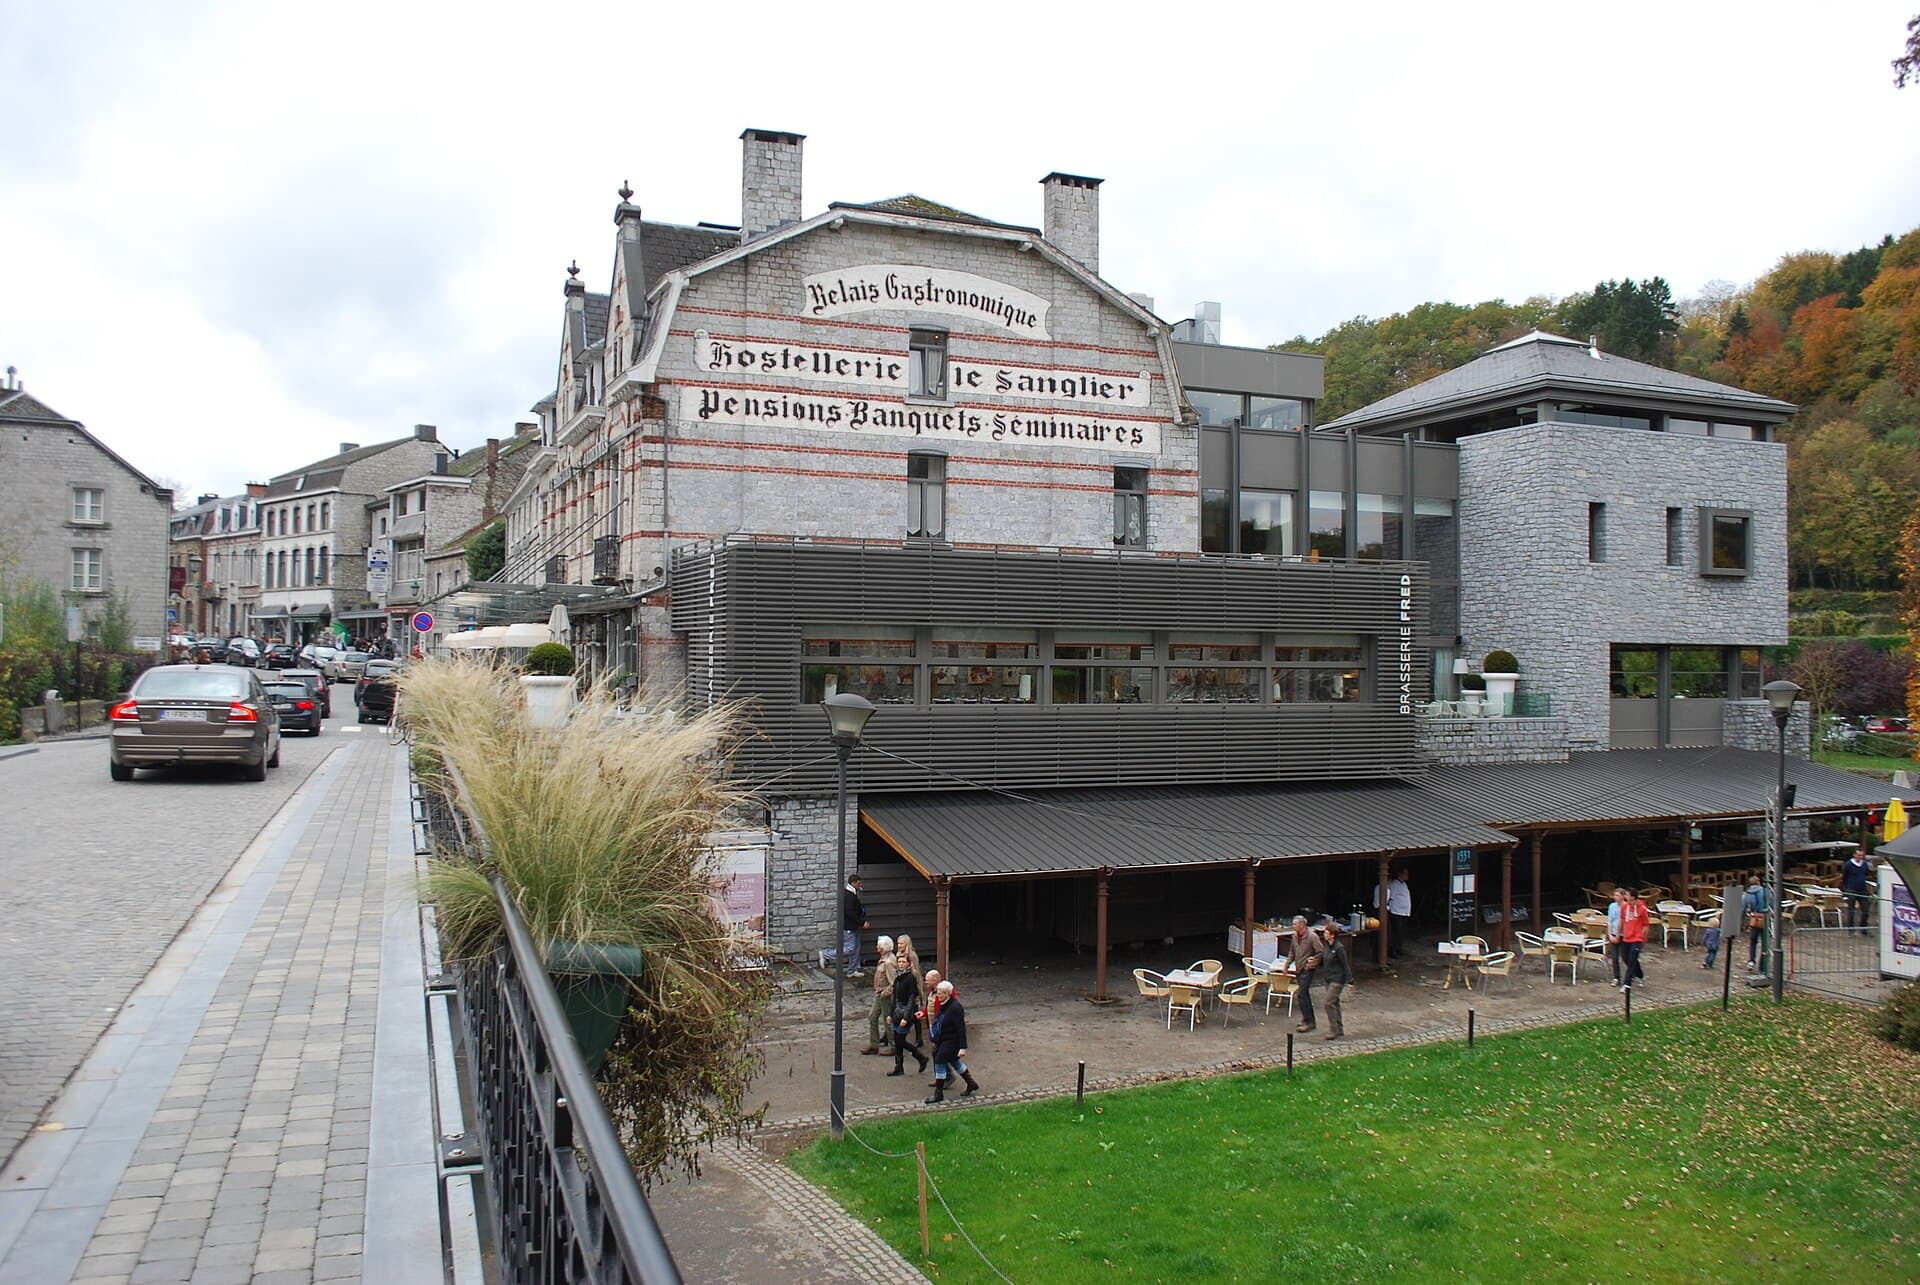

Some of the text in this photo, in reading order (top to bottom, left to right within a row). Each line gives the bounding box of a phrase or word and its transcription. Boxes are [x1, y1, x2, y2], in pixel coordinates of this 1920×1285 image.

[807, 272, 1038, 328] Relais Gastronomique
[709, 341, 1135, 400] Hostellerie le Sanglier
[698, 388, 1144, 449] Pensions Banquets Séminaires
[1400, 574, 1411, 714] BRASSERIE FRED
